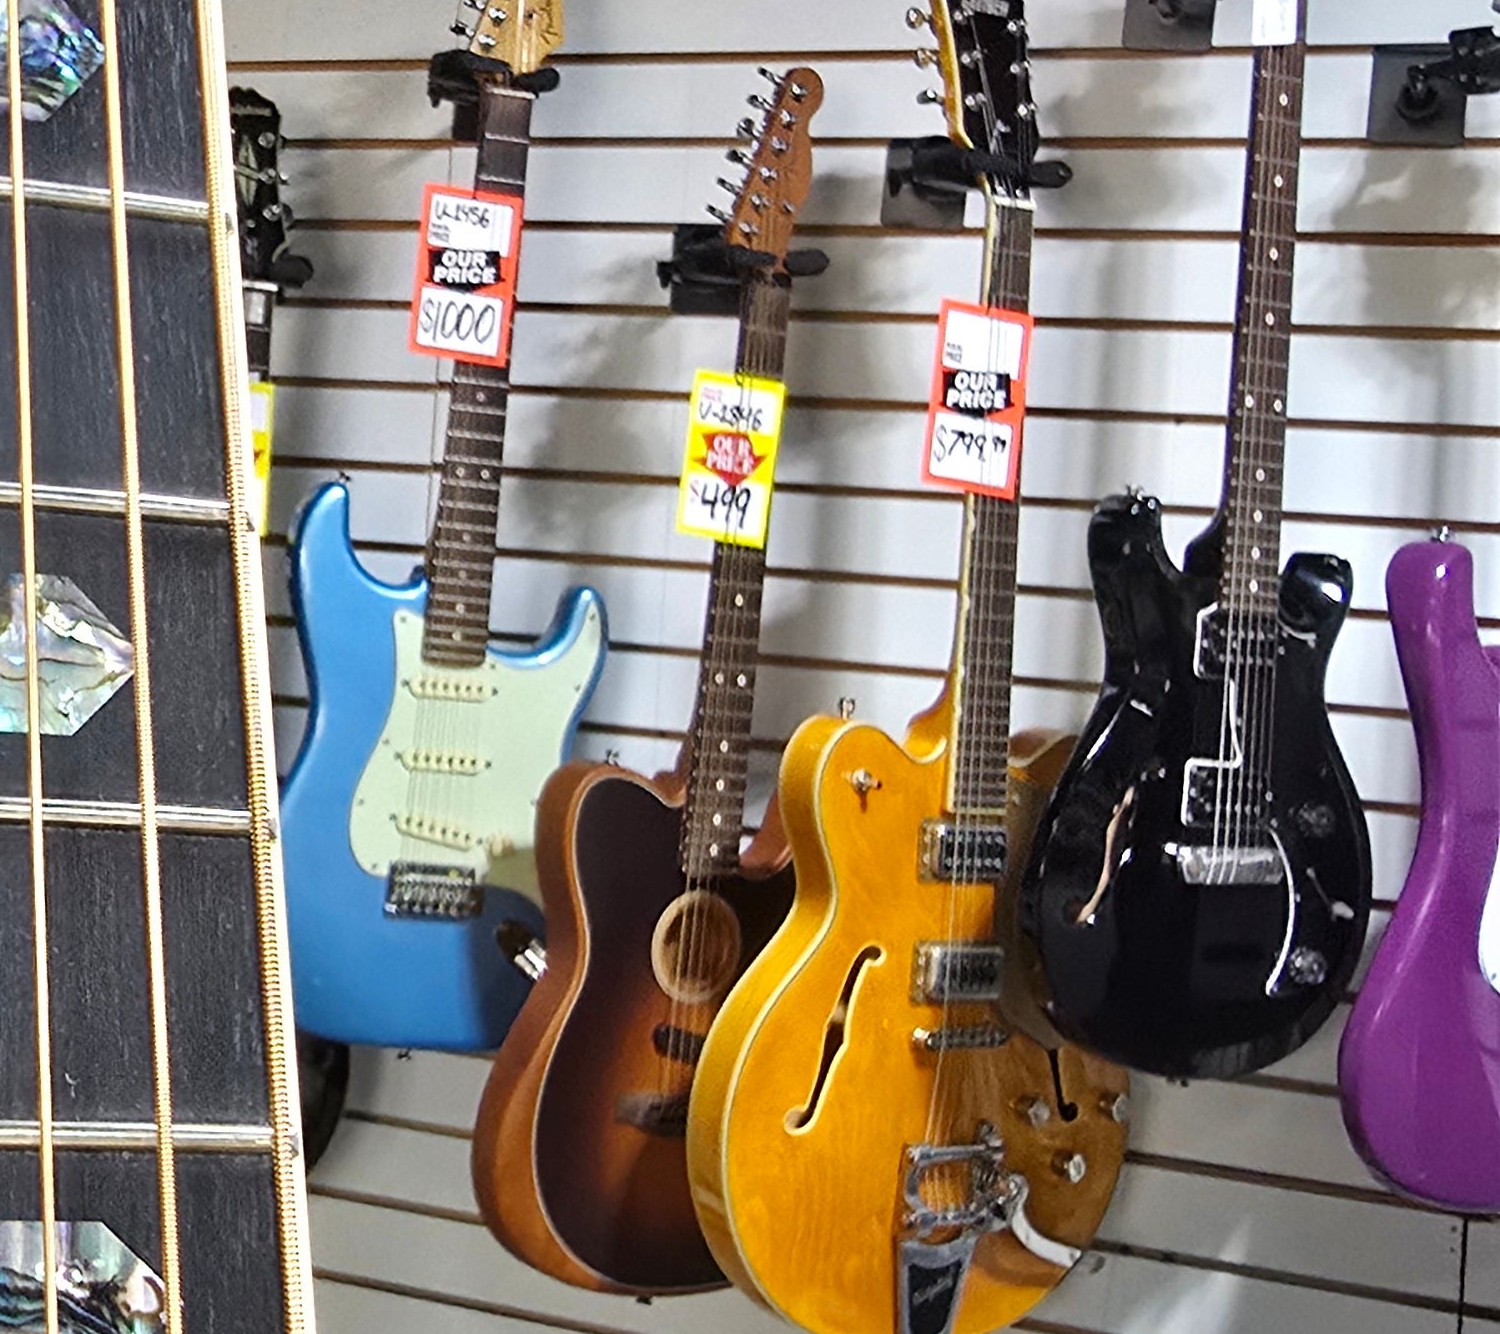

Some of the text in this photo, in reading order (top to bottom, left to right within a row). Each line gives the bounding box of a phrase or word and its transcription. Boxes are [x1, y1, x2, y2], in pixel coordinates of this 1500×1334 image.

[441, 249, 488, 268] OUR
[432, 265, 497, 284] PRICE
[419, 297, 496, 344] $1000
[954, 371, 998, 391] OUR
[947, 389, 1007, 409] PRICE
[713, 435, 752, 455] OUR
[706, 452, 757, 475] PRICE
